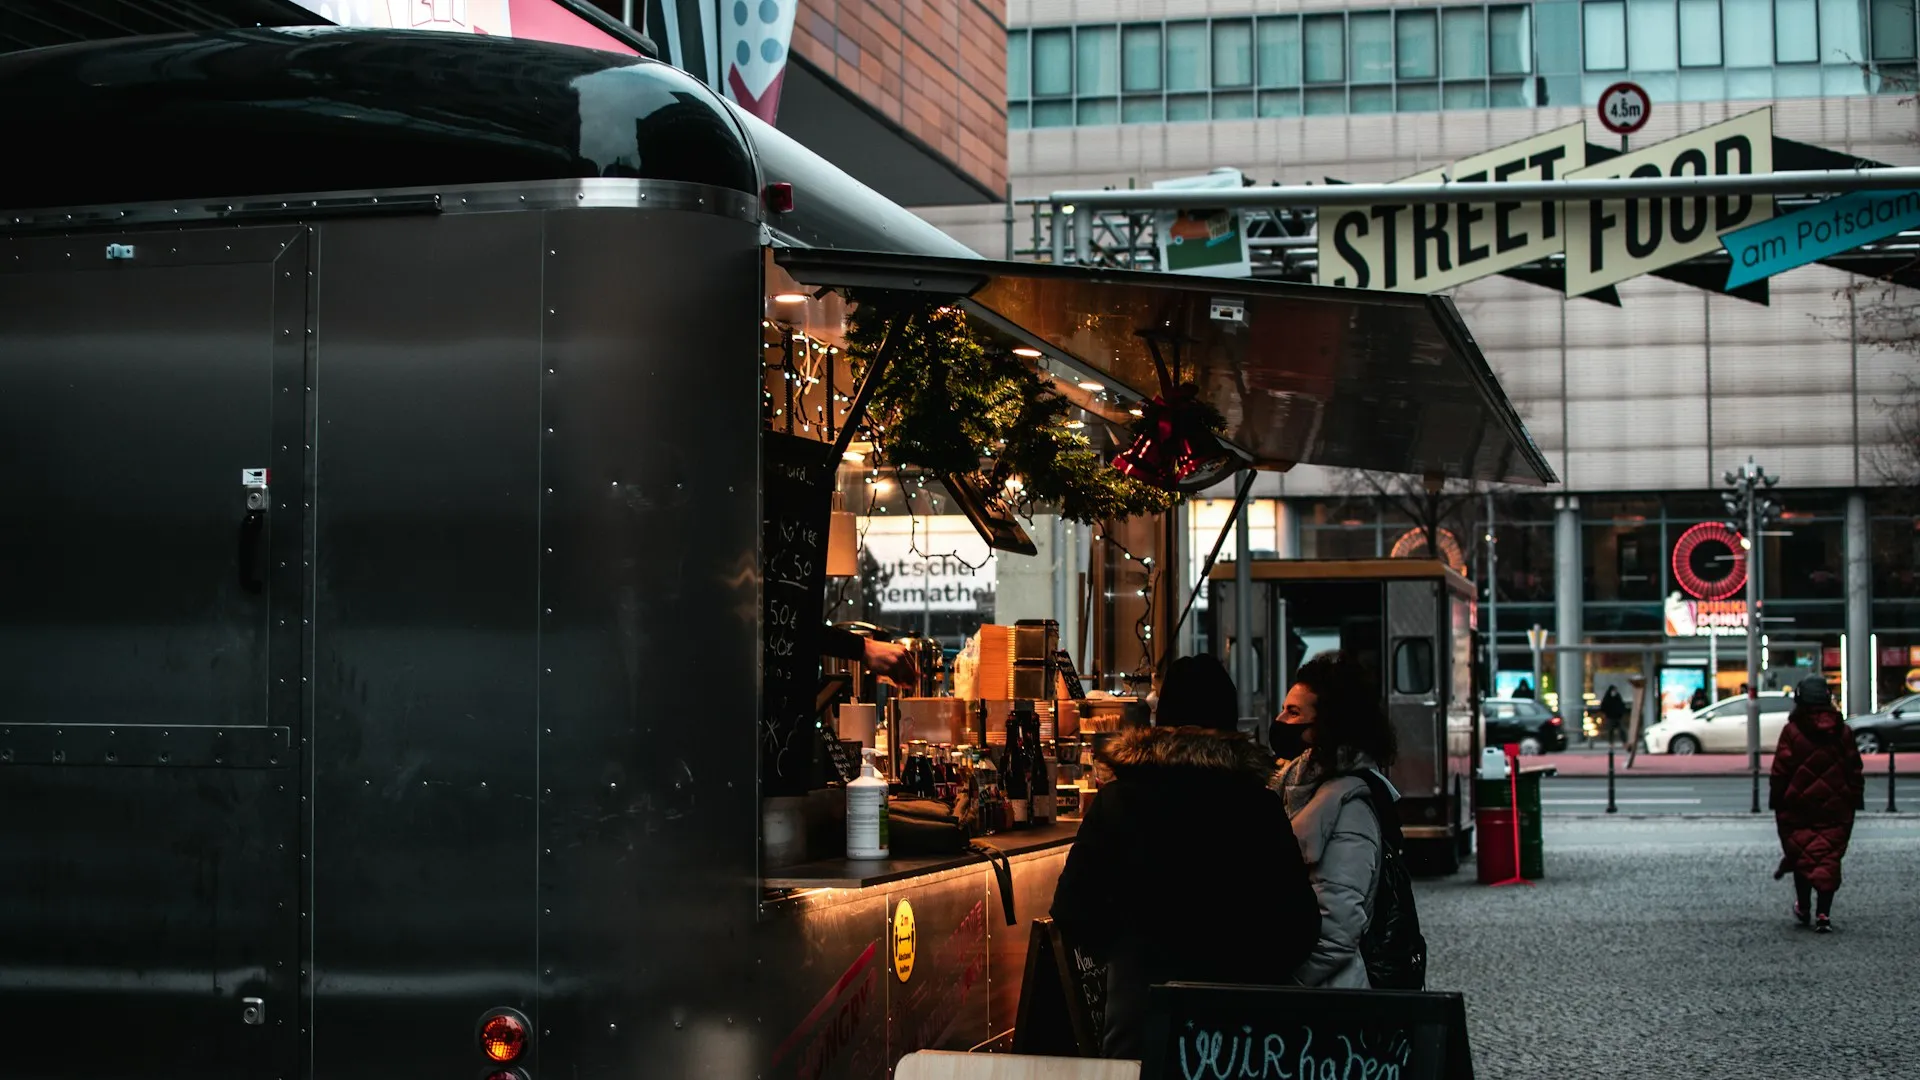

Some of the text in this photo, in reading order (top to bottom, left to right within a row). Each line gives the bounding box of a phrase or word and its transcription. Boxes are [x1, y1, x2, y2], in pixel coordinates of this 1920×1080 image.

[1333, 134, 1753, 290] STREET FOOD
[1741, 235, 1787, 267] am
